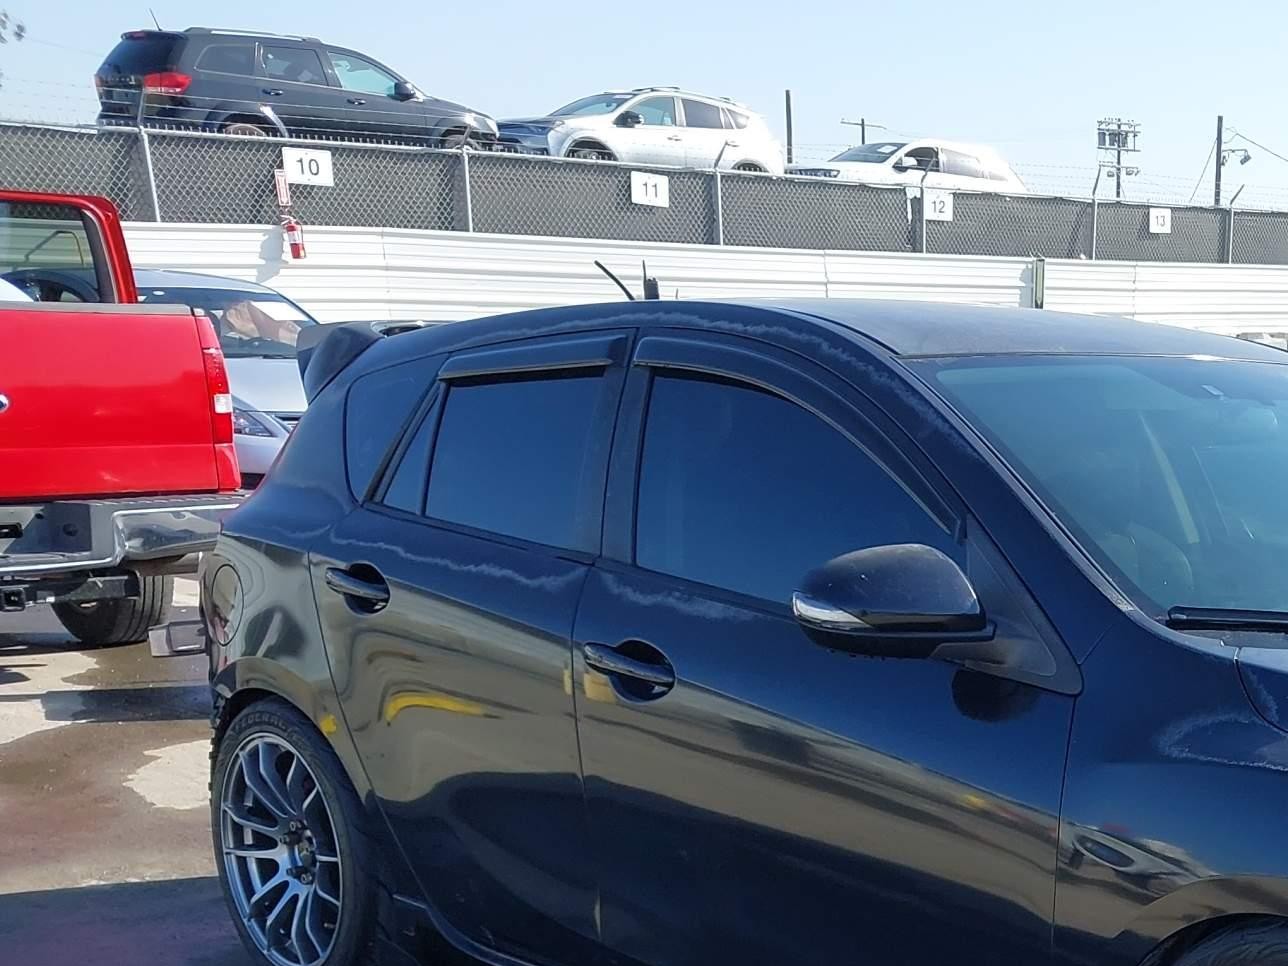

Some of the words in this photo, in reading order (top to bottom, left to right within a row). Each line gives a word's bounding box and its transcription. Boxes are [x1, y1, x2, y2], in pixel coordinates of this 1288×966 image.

[296, 157, 320, 176] 10
[642, 181, 658, 198] 11
[931, 199, 946, 214] 12
[1155, 215, 1166, 227] 13
